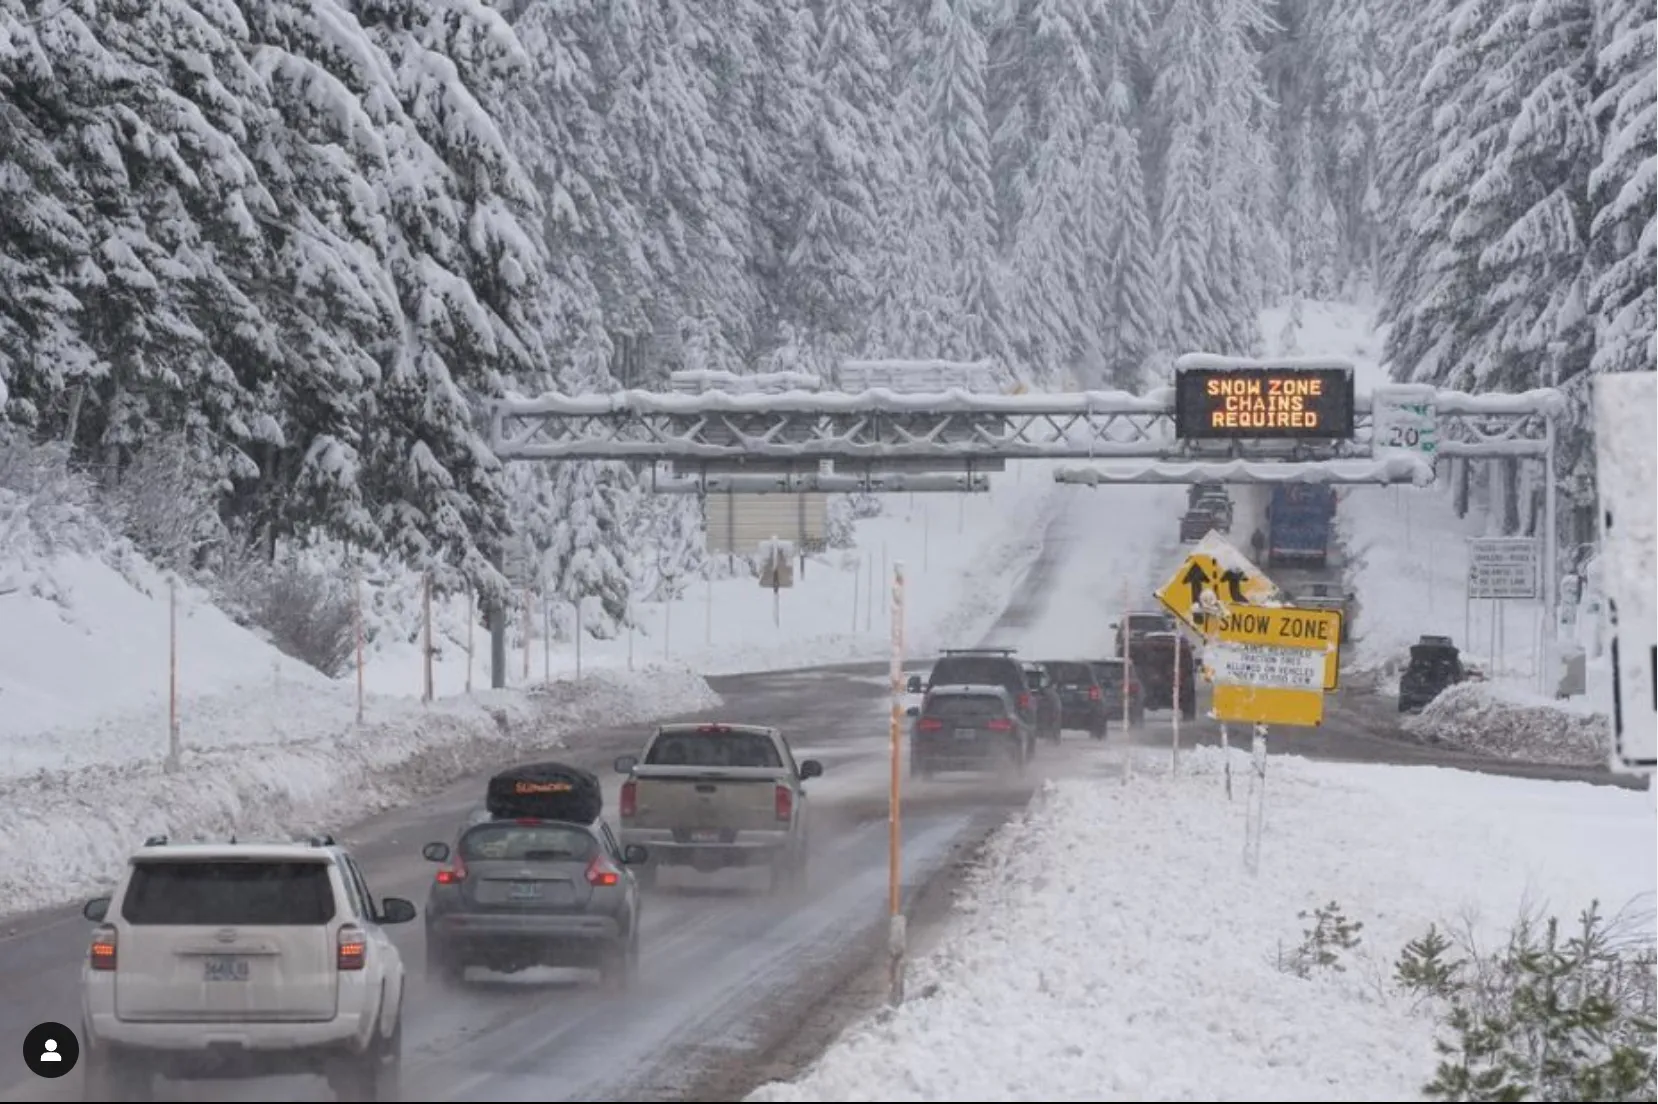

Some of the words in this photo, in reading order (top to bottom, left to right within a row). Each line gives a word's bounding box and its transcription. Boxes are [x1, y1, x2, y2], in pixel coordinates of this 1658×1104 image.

[1206, 379, 1261, 396] SNOW
[1267, 379, 1322, 396] ZONE
[1226, 396, 1304, 412] CHAINS
[1211, 411, 1318, 428] REQUIRED
[1389, 426, 1420, 447] 20
[1219, 614, 1270, 635] SNOW
[1279, 617, 1329, 640] ZONE
[1226, 662, 1261, 673] ALLOWED
